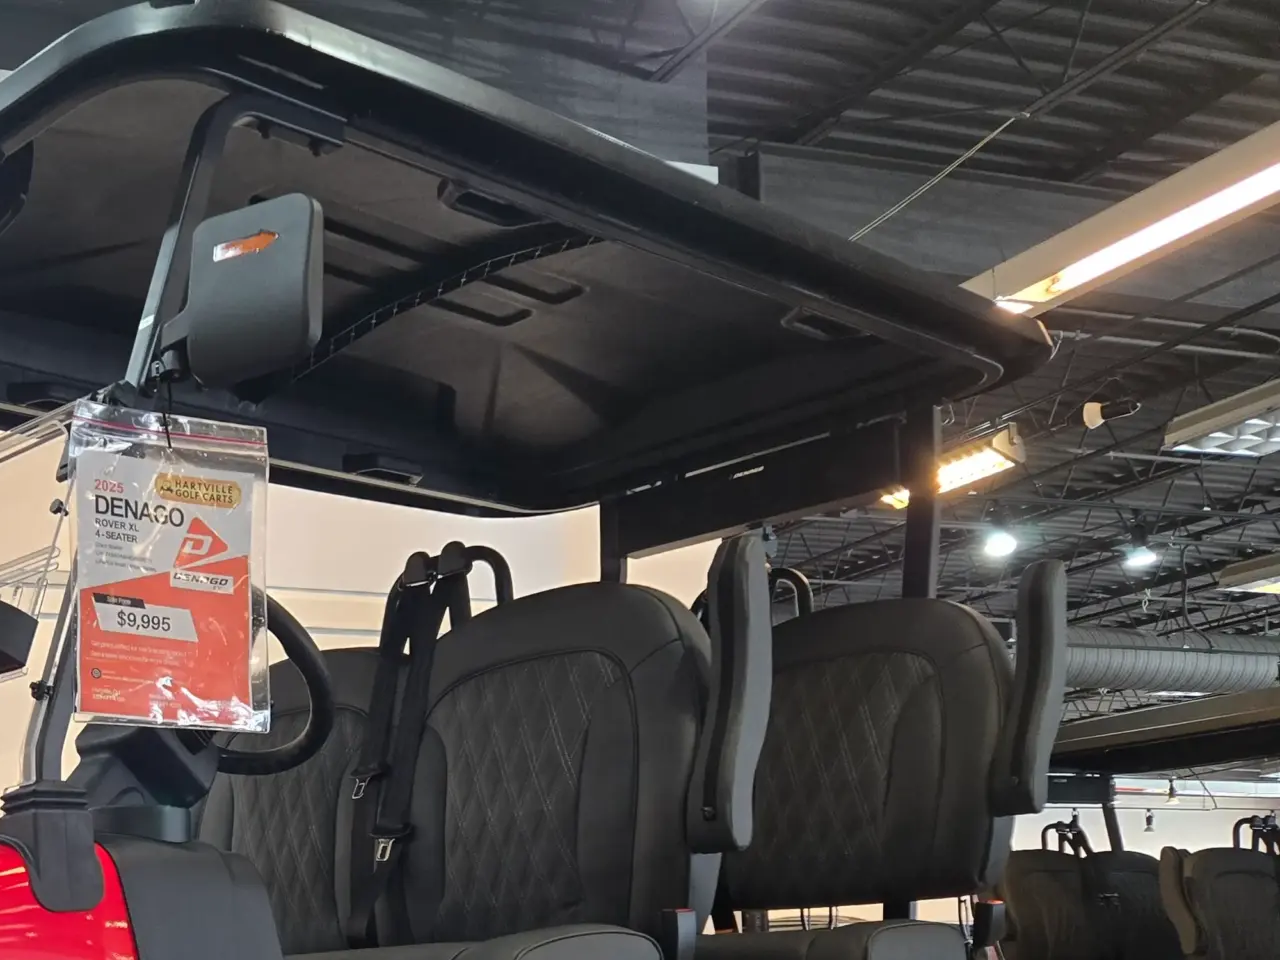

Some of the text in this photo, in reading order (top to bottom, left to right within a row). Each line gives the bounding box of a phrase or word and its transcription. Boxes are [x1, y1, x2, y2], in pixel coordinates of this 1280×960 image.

[94, 479, 124, 493] 2025
[175, 480, 233, 494] HARTVILLE
[175, 489, 233, 503] GOLF CARTS
[95, 494, 184, 527] DENAGO
[95, 518, 139, 532] ROVER XL
[117, 609, 171, 632] $9,995
